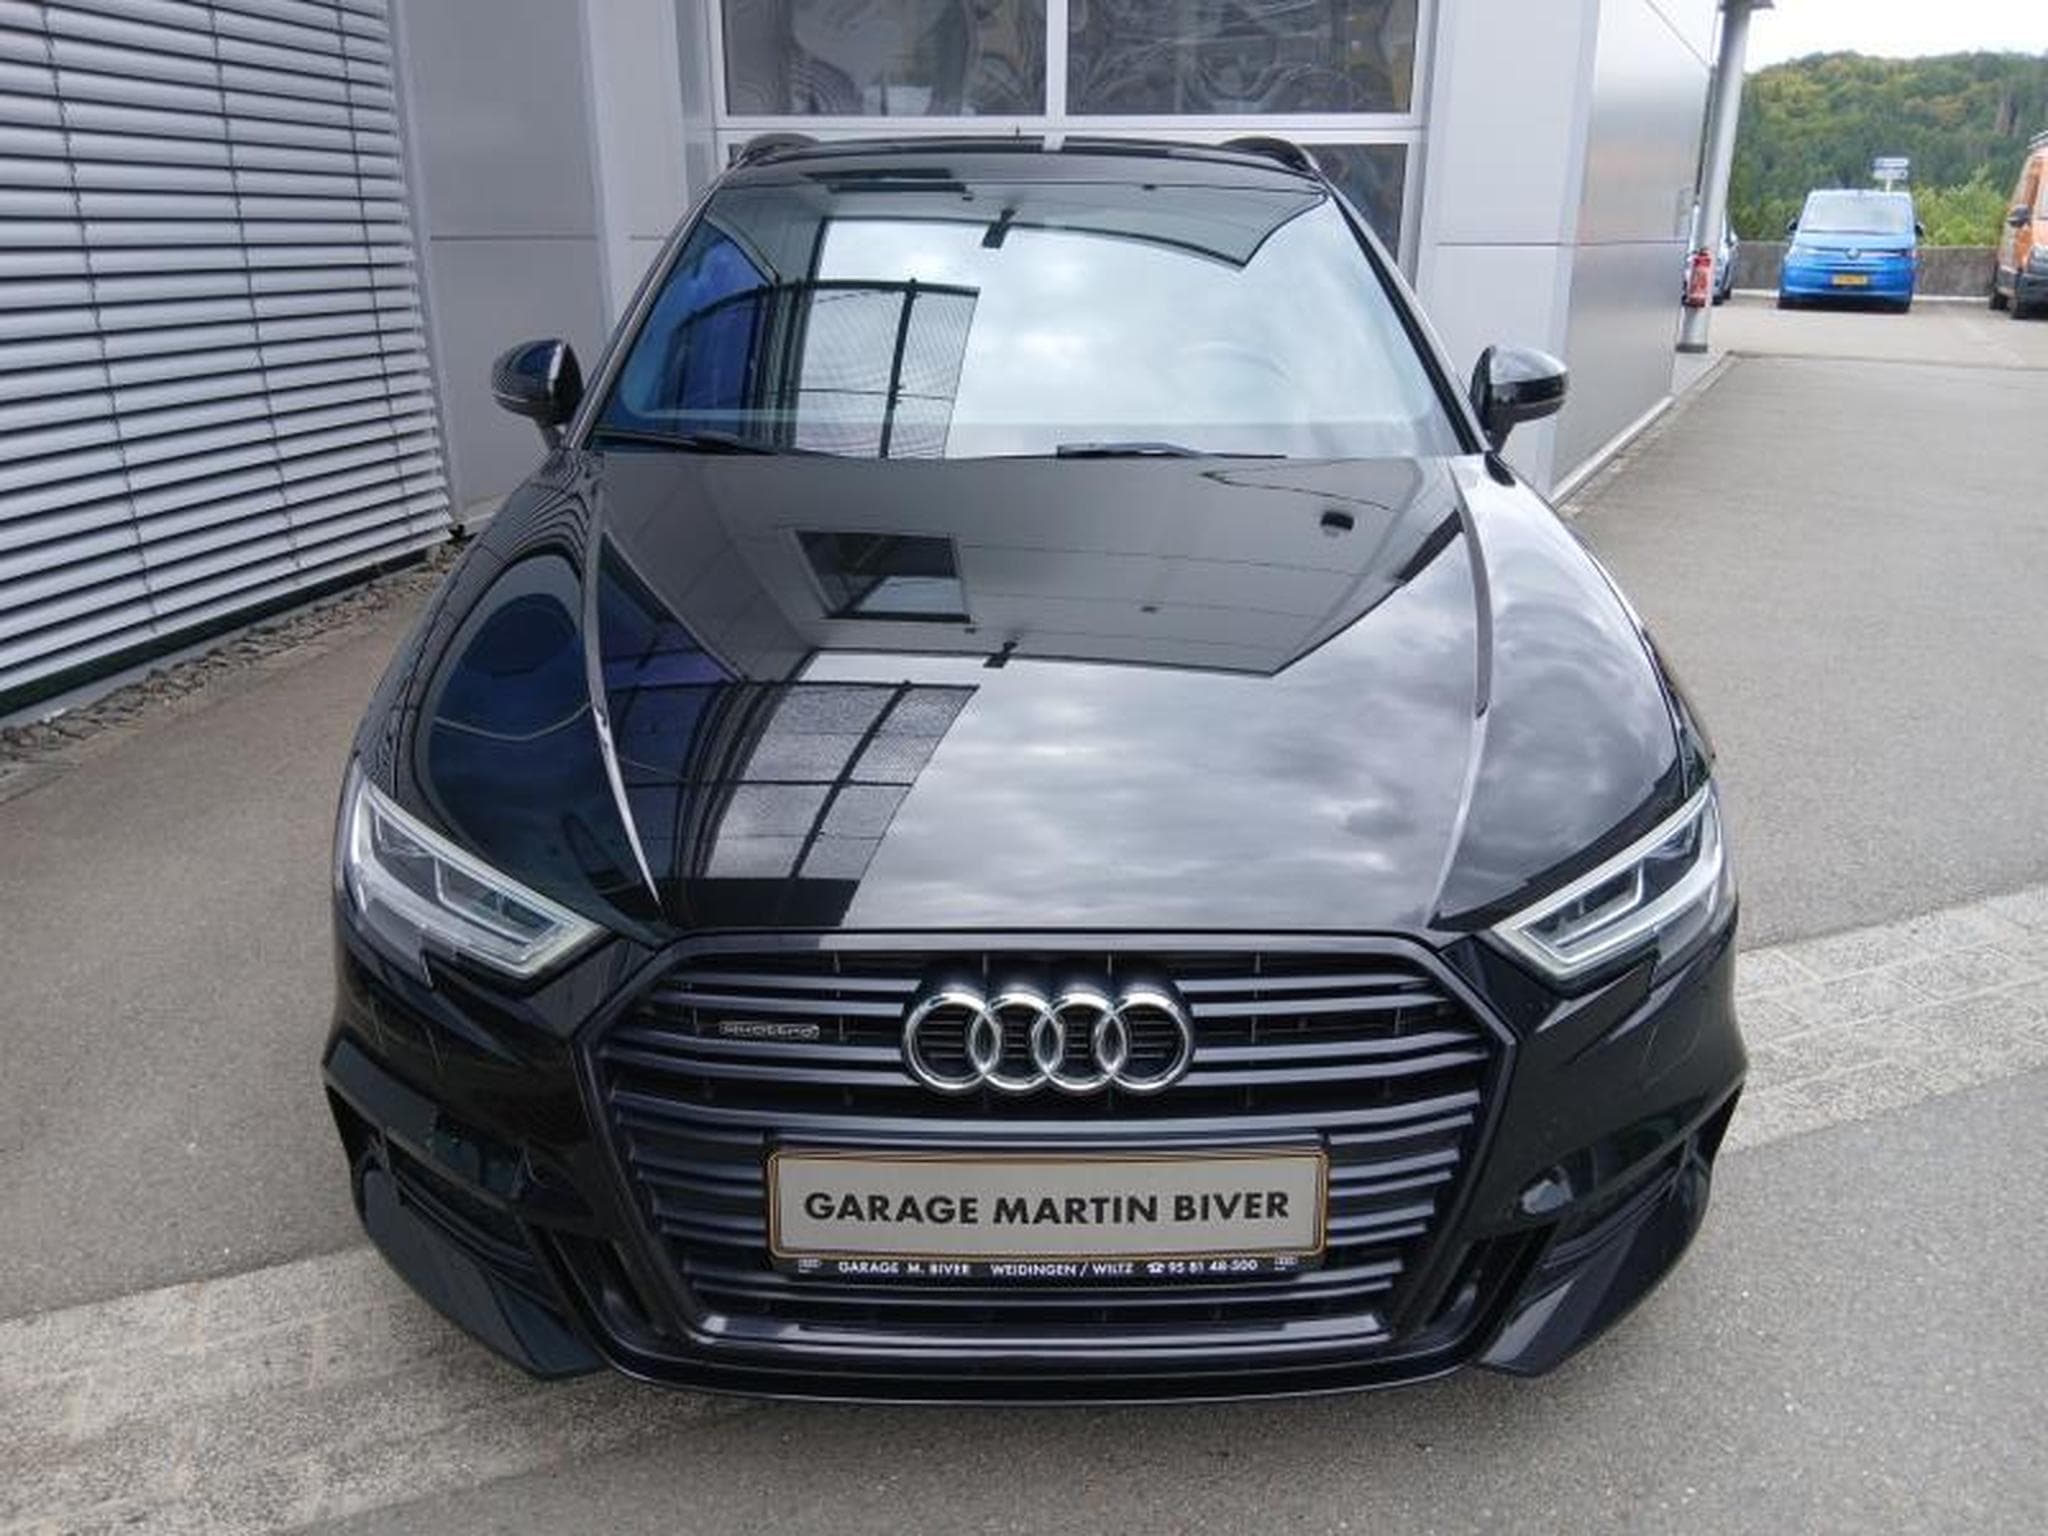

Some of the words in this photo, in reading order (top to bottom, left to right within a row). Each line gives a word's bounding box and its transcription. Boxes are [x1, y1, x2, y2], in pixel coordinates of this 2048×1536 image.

[804, 1192, 979, 1224] GARAGE
[993, 1196, 1158, 1225] MARTIN
[1174, 1191, 1289, 1222] BIVER
[838, 1260, 899, 1274] GARAGE
[907, 1262, 925, 1275] M.
[929, 1263, 971, 1275] BIVER
[990, 1263, 1077, 1276] WEIDINGEN
[1092, 1262, 1134, 1275] WILTZ
